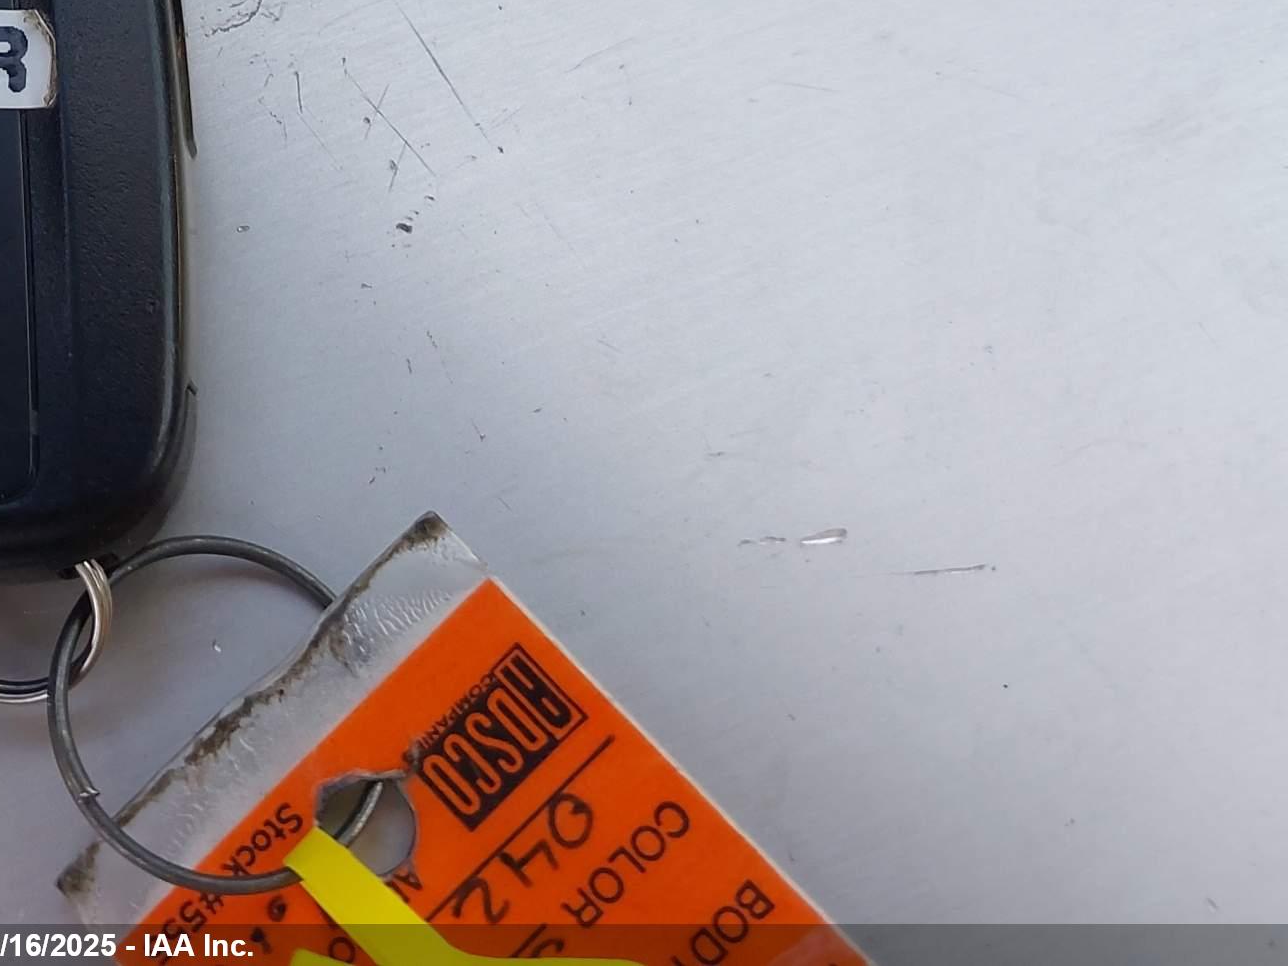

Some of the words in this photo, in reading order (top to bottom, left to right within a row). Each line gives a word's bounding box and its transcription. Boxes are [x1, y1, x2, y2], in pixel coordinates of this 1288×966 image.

[220, 802, 304, 877] Stock
[450, 792, 594, 925] 042
[562, 800, 691, 929] COLOR
